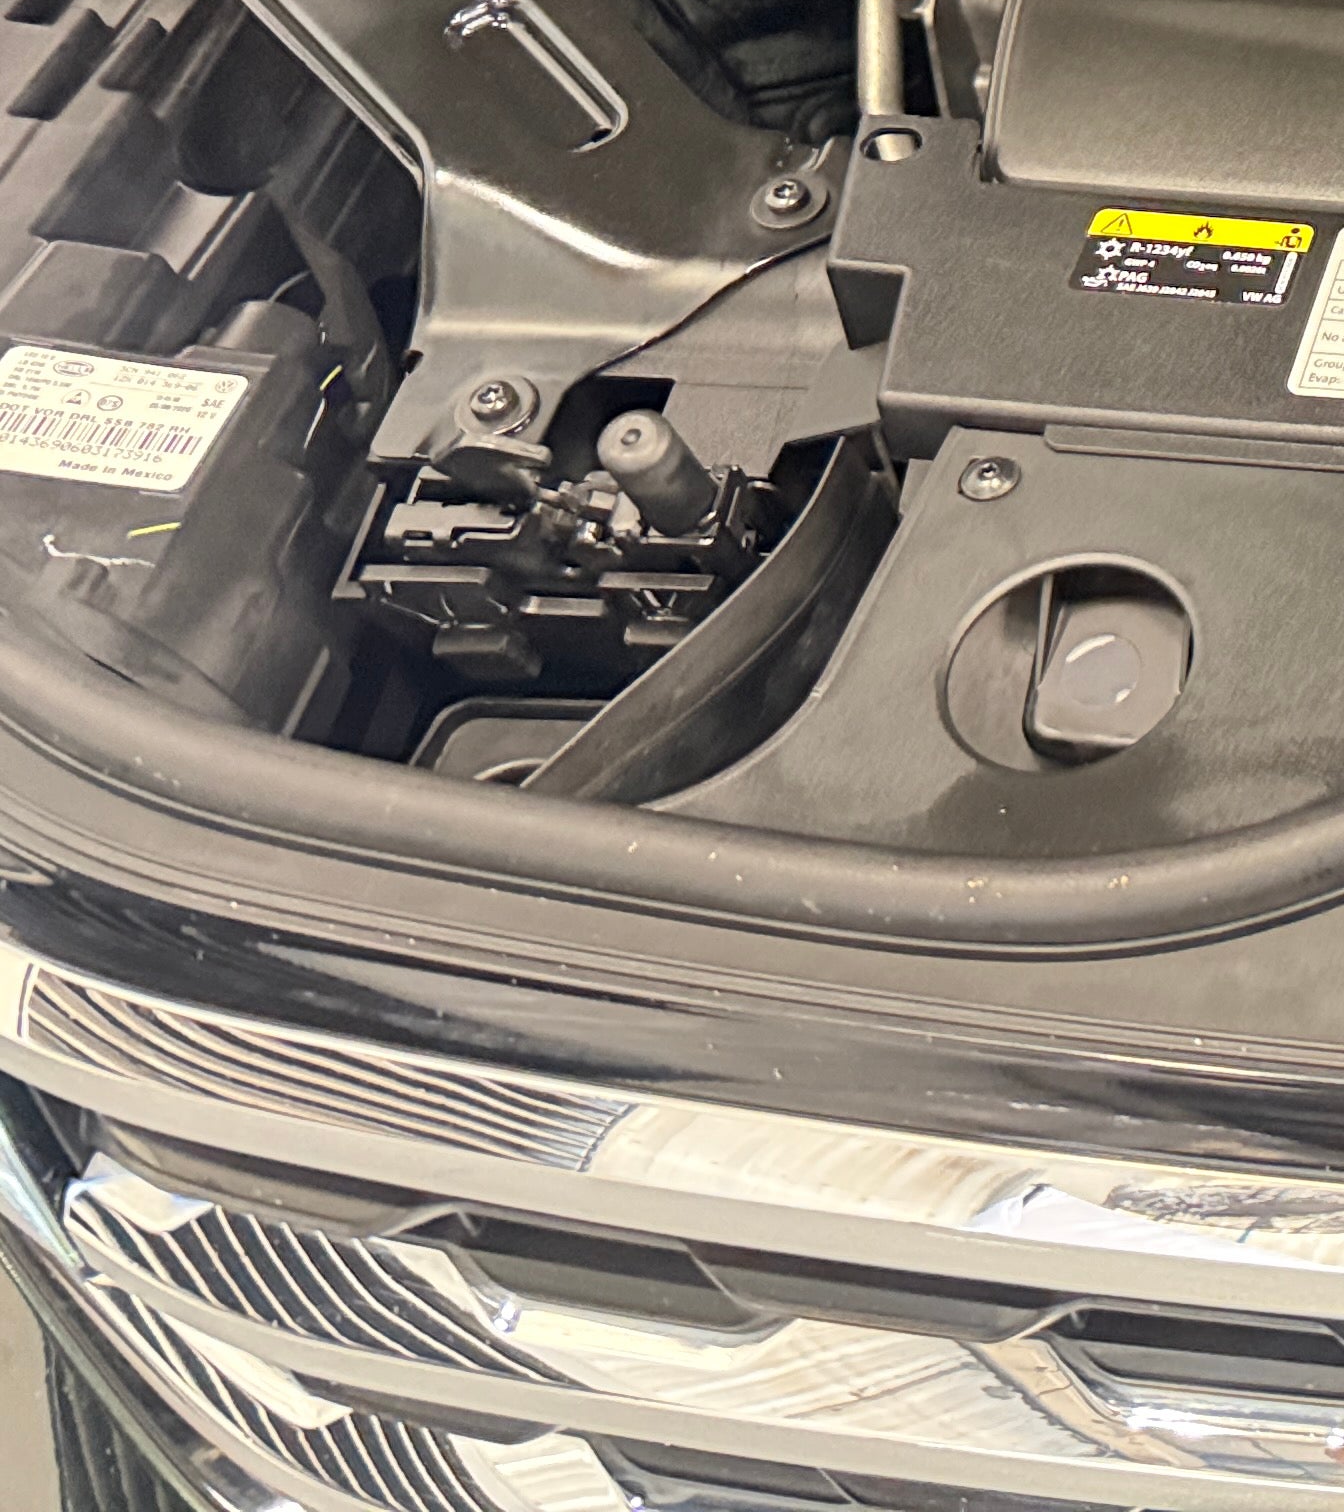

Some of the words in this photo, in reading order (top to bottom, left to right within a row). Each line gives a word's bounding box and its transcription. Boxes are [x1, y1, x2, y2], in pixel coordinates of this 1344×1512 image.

[1129, 240, 1195, 259] R-1234yf
[1119, 270, 1150, 285] PAG
[1242, 291, 1264, 303] VW
[1263, 294, 1284, 305] AG
[1321, 331, 1339, 343] No
[201, 398, 226, 409] SAE
[57, 459, 98, 473] Made
[121, 467, 174, 482] Mexico
